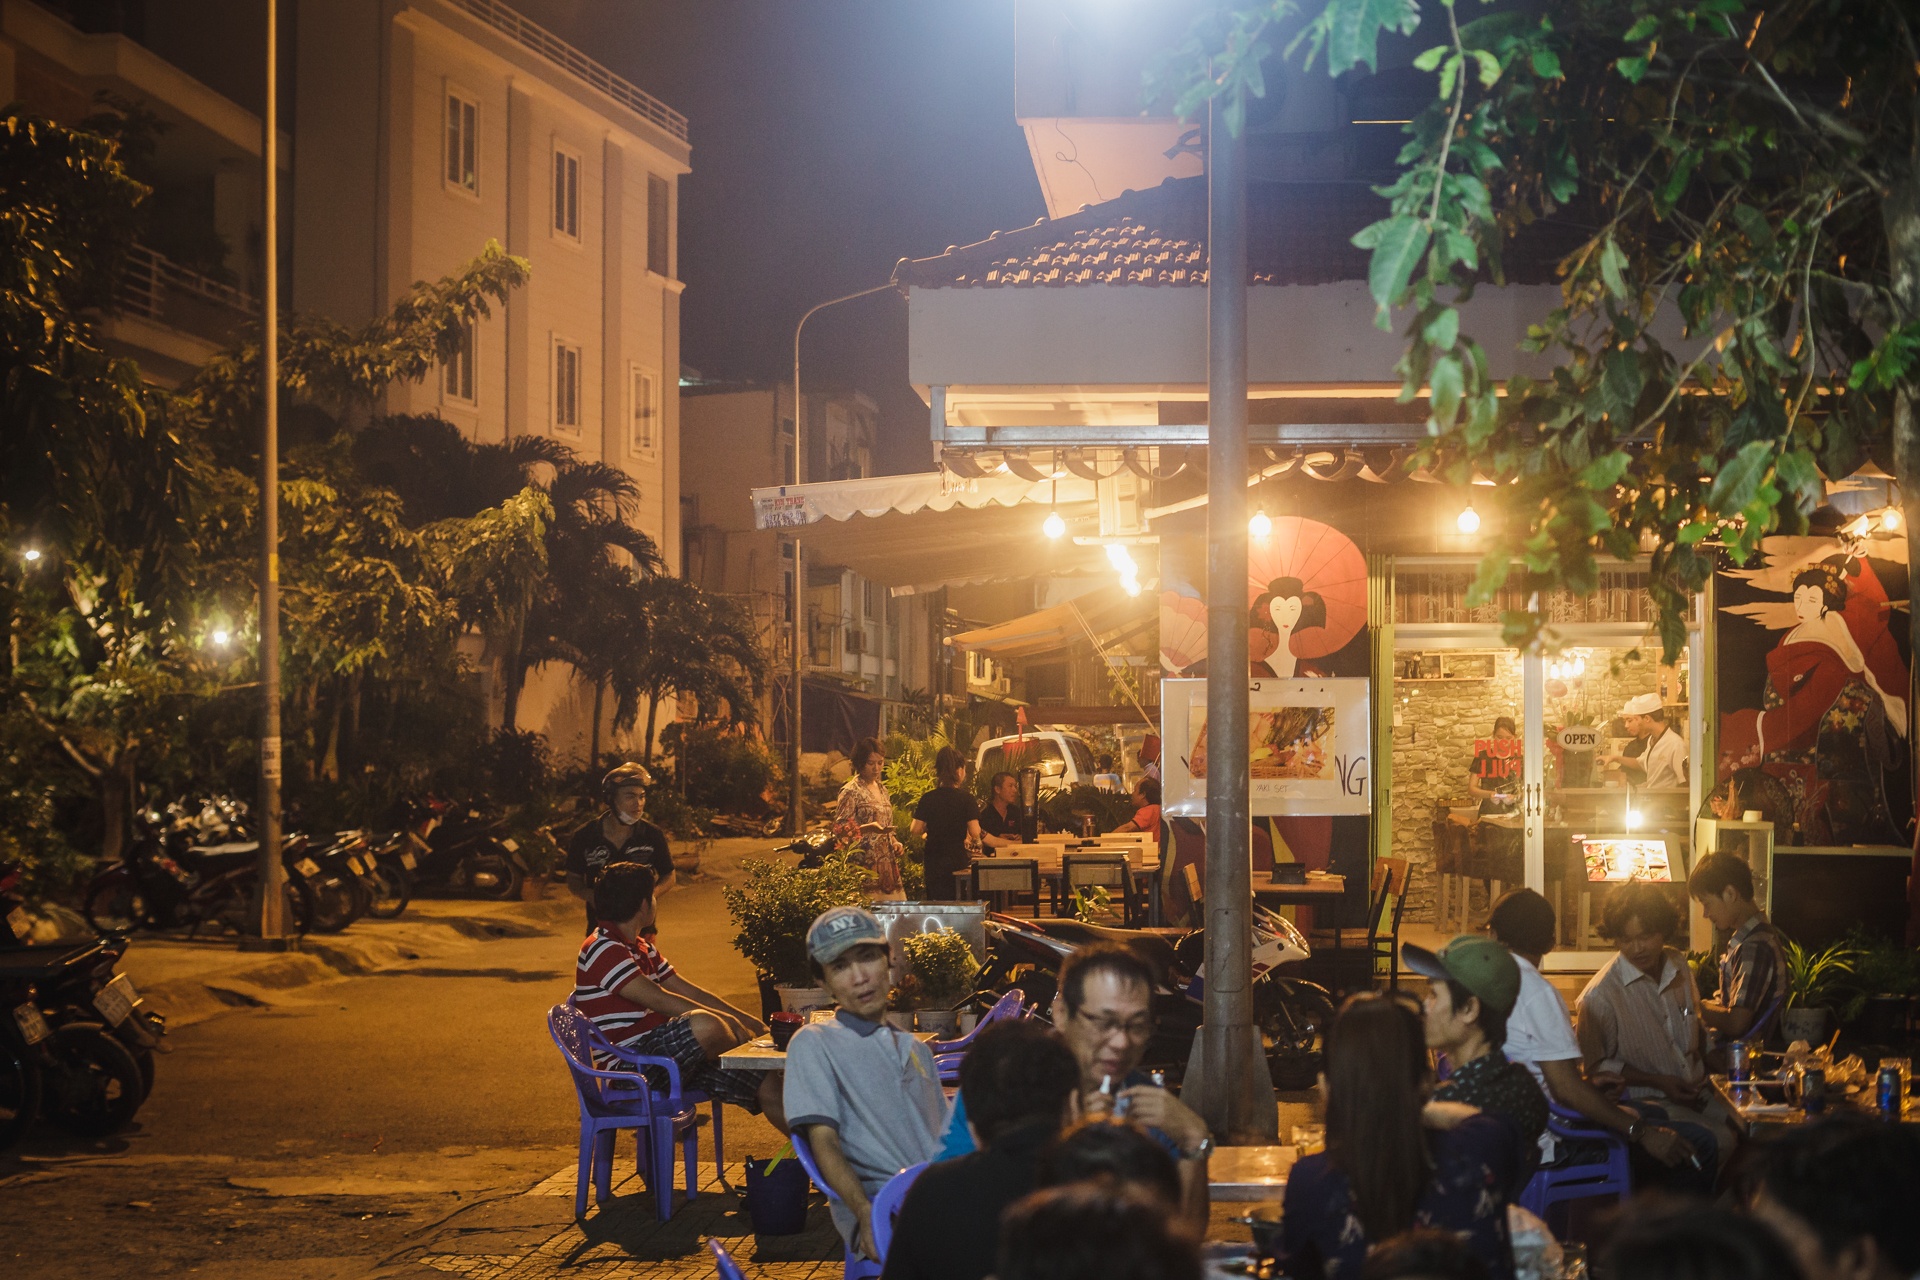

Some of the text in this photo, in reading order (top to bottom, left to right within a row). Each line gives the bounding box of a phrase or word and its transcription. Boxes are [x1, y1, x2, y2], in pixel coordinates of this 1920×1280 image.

[1564, 733, 1596, 745] OPEN
[1474, 739, 1522, 758] PUSH
[831, 916, 857, 932] NY
